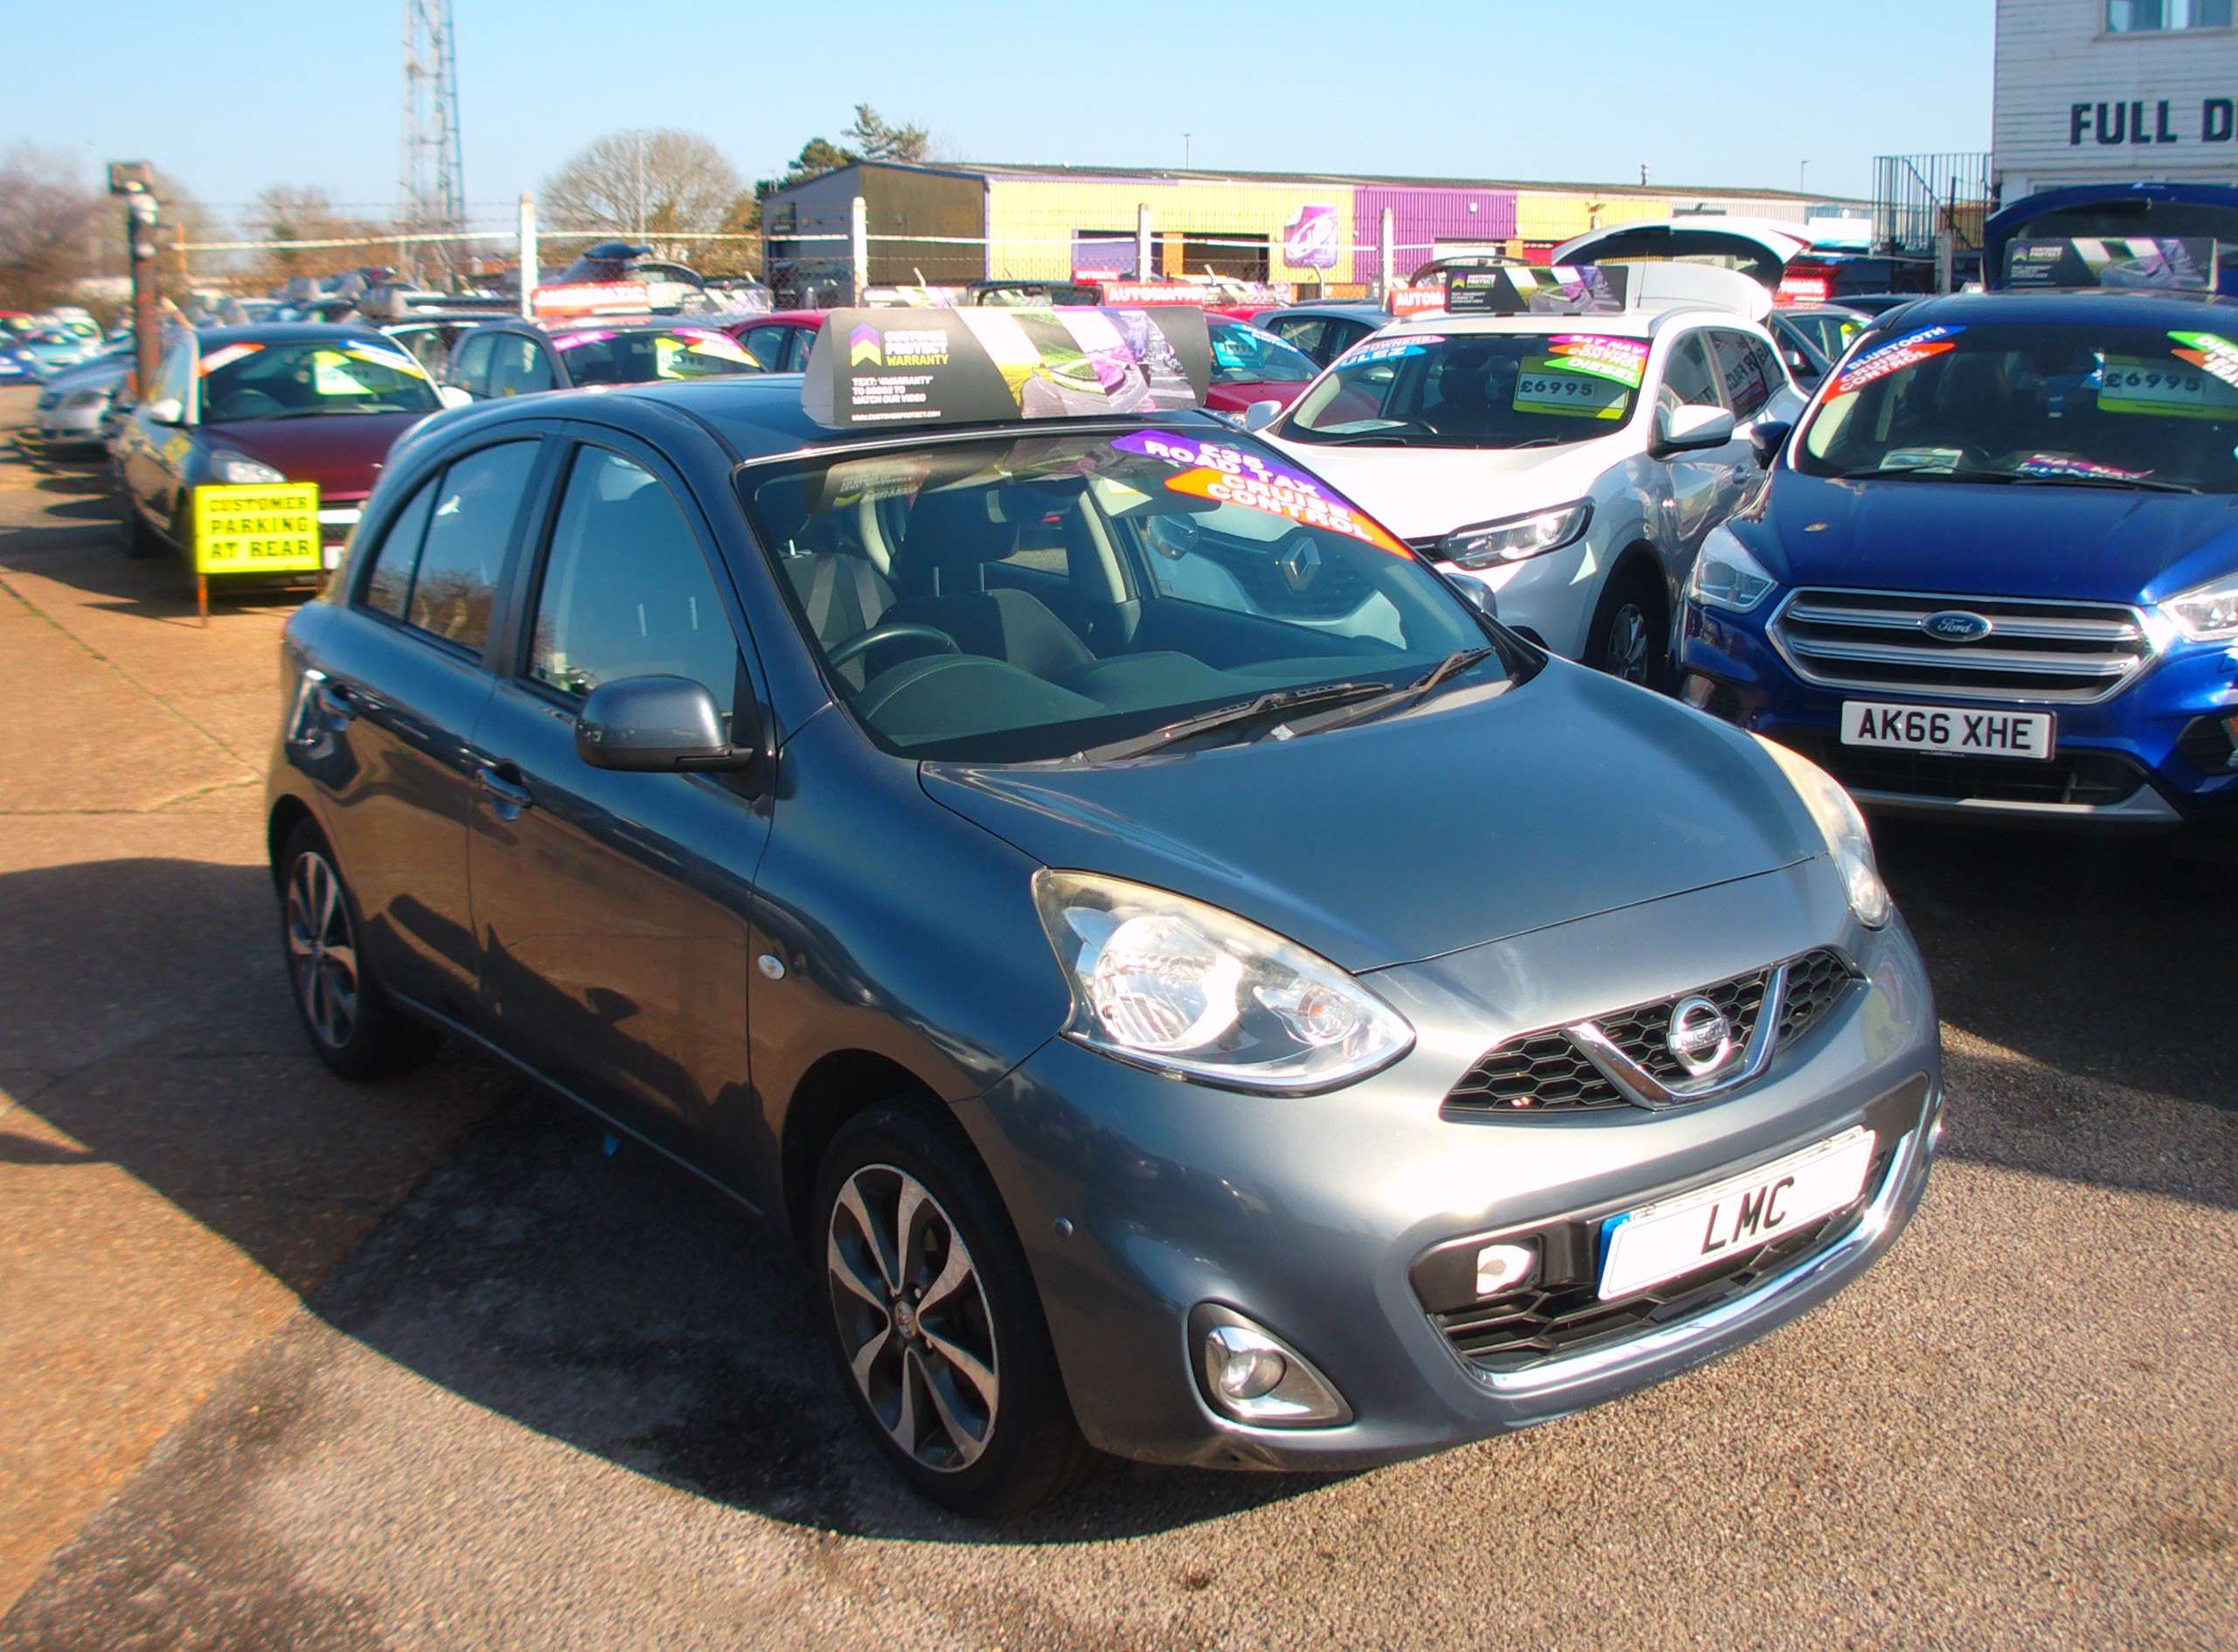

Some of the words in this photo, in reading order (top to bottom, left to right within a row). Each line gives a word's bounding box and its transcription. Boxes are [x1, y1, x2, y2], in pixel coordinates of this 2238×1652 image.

[2070, 100, 2178, 145] FULL
[2202, 98, 2238, 142] D
[886, 354, 949, 366] WARRANTY
[1841, 348, 1914, 382] CRUISE
[1846, 326, 1947, 370] BLUETOOTH
[1519, 380, 1593, 396] £6995
[1838, 351, 1931, 392] CONTROL
[1143, 441, 1242, 475] ROAD
[1255, 468, 1323, 498] TAX
[1199, 443, 1265, 470] £35
[210, 496, 307, 512] CUSTOMER
[1206, 483, 1374, 541] CONTROL
[1221, 475, 1352, 518] CRUISE
[211, 517, 308, 534] PARKING
[211, 542, 238, 559] AT
[250, 539, 309, 557] REAR
[1936, 616, 1973, 634] Ford
[1857, 708, 1951, 745] AK66
[1962, 714, 2033, 751] XHE
[1700, 1176, 1795, 1255] LMC
